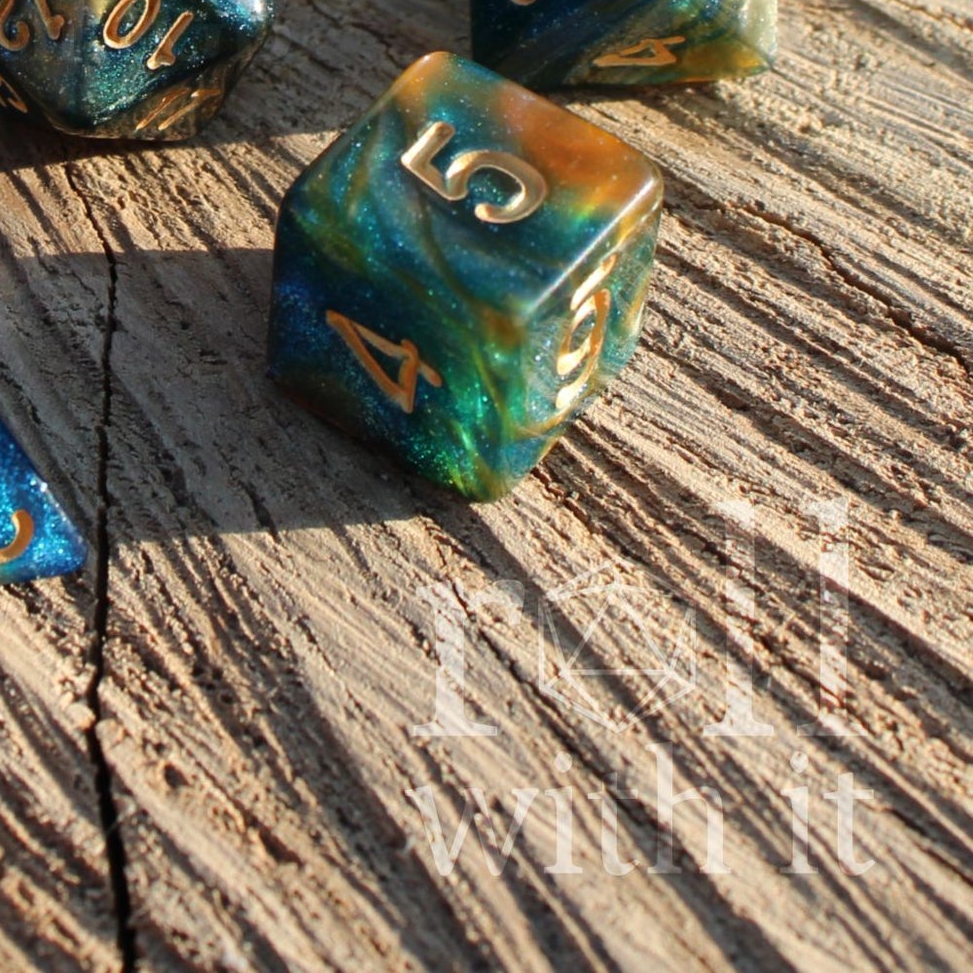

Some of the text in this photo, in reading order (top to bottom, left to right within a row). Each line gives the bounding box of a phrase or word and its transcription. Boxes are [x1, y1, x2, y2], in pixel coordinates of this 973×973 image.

[593, 35, 685, 66] 4
[401, 121, 547, 223] 5
[326, 310, 442, 413] 4
